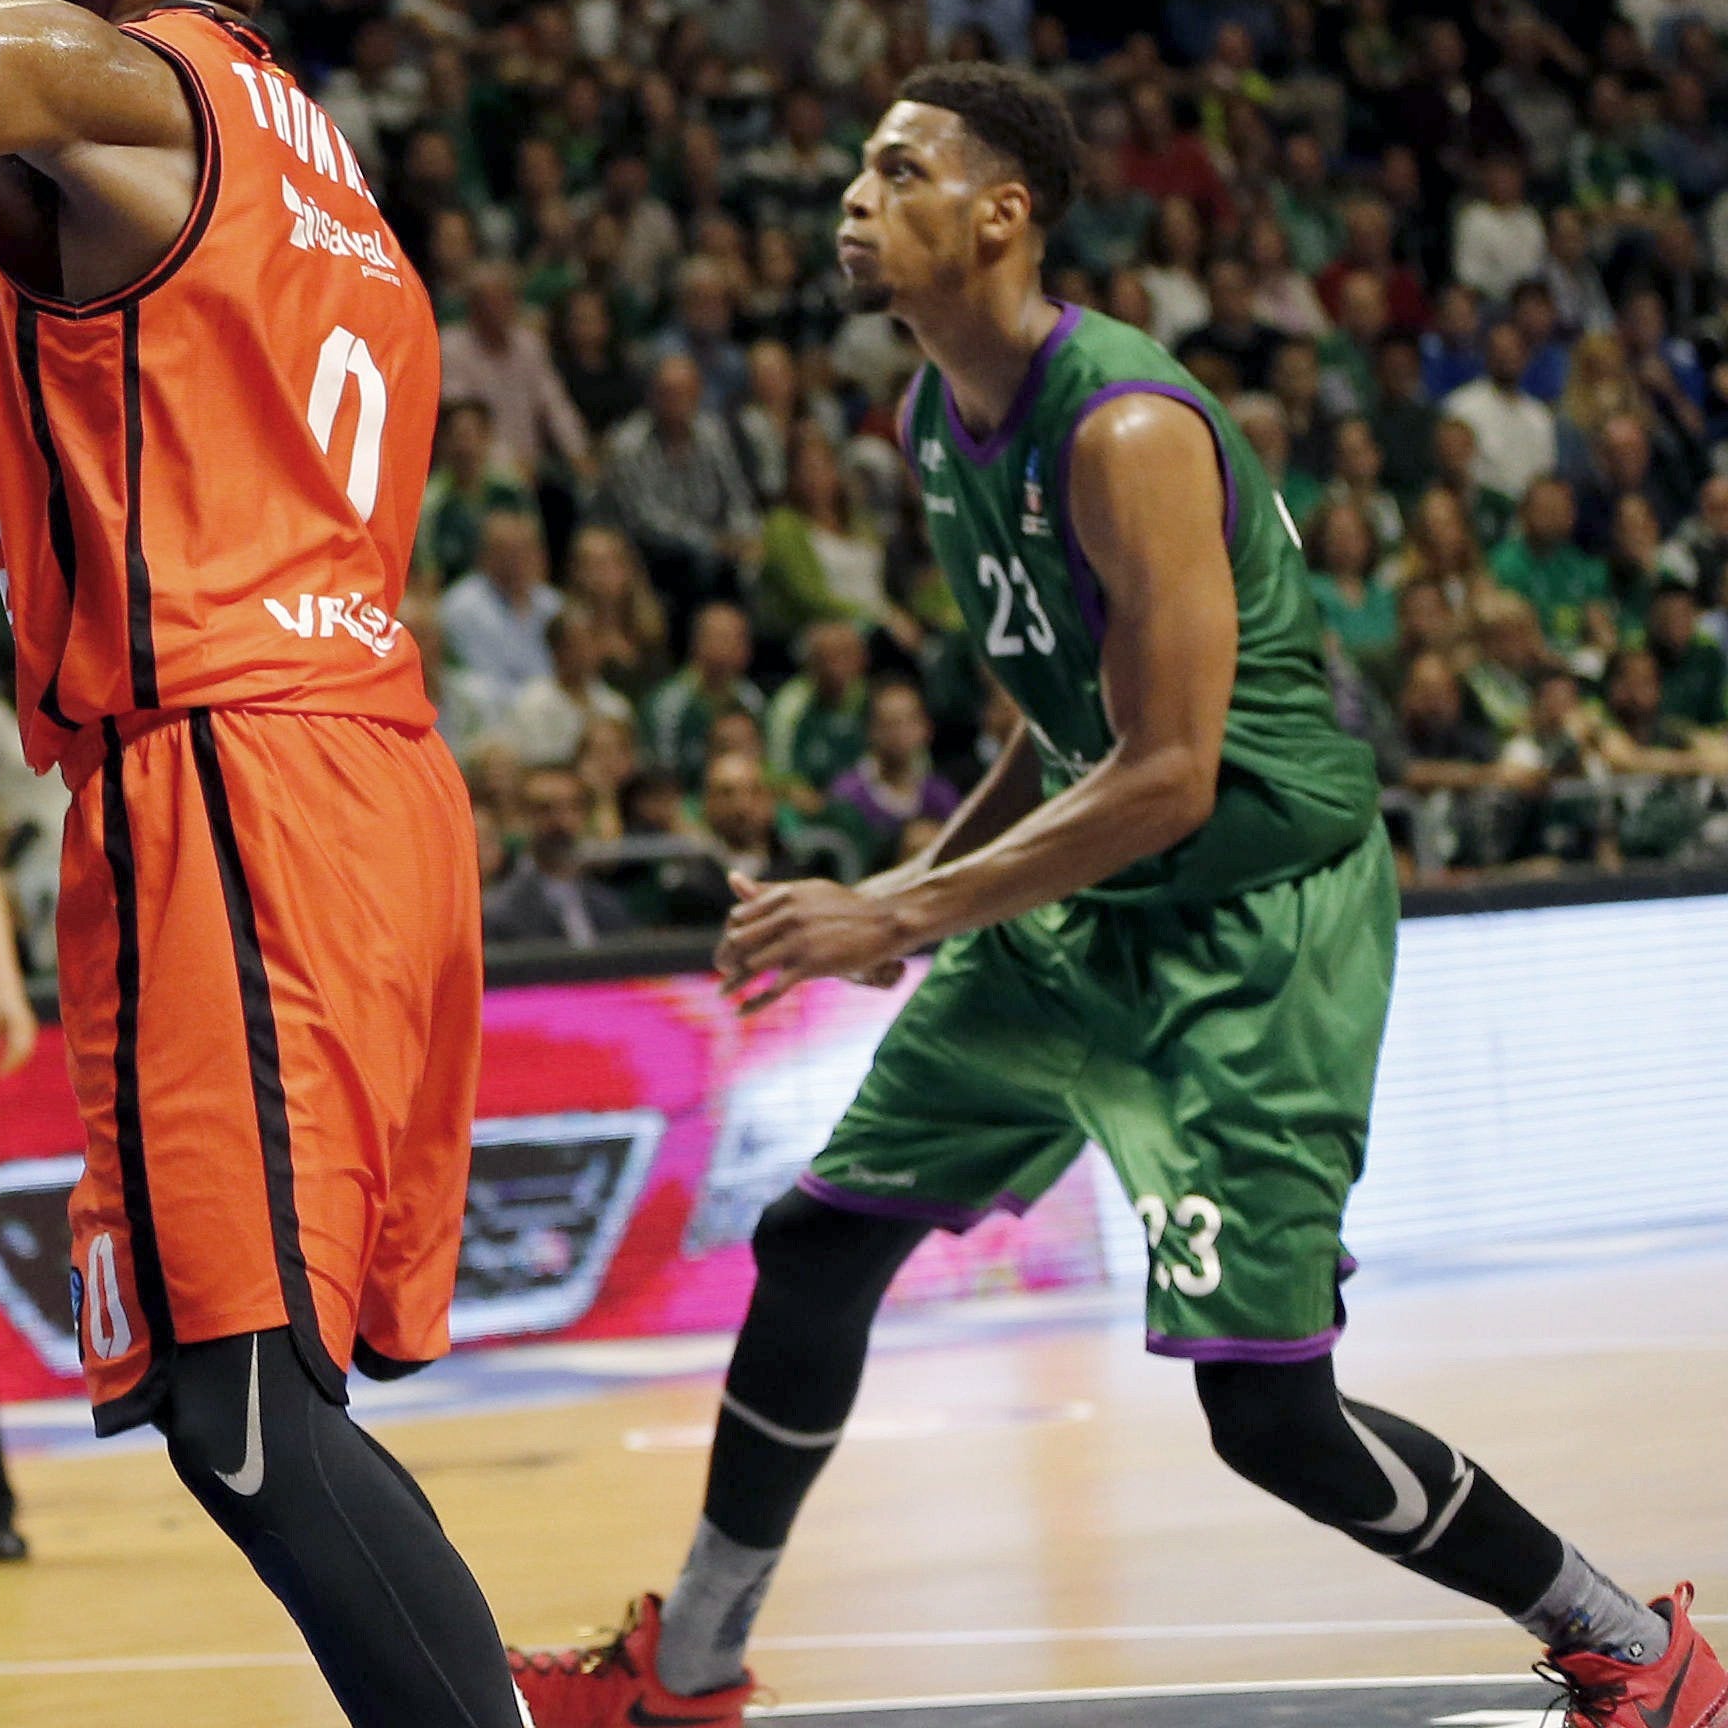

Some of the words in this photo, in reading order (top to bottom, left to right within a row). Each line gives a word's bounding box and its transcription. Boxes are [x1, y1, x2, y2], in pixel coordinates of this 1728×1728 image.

[307, 324, 388, 524] 0
[978, 553, 1056, 656] 23
[87, 1231, 133, 1360] 0
